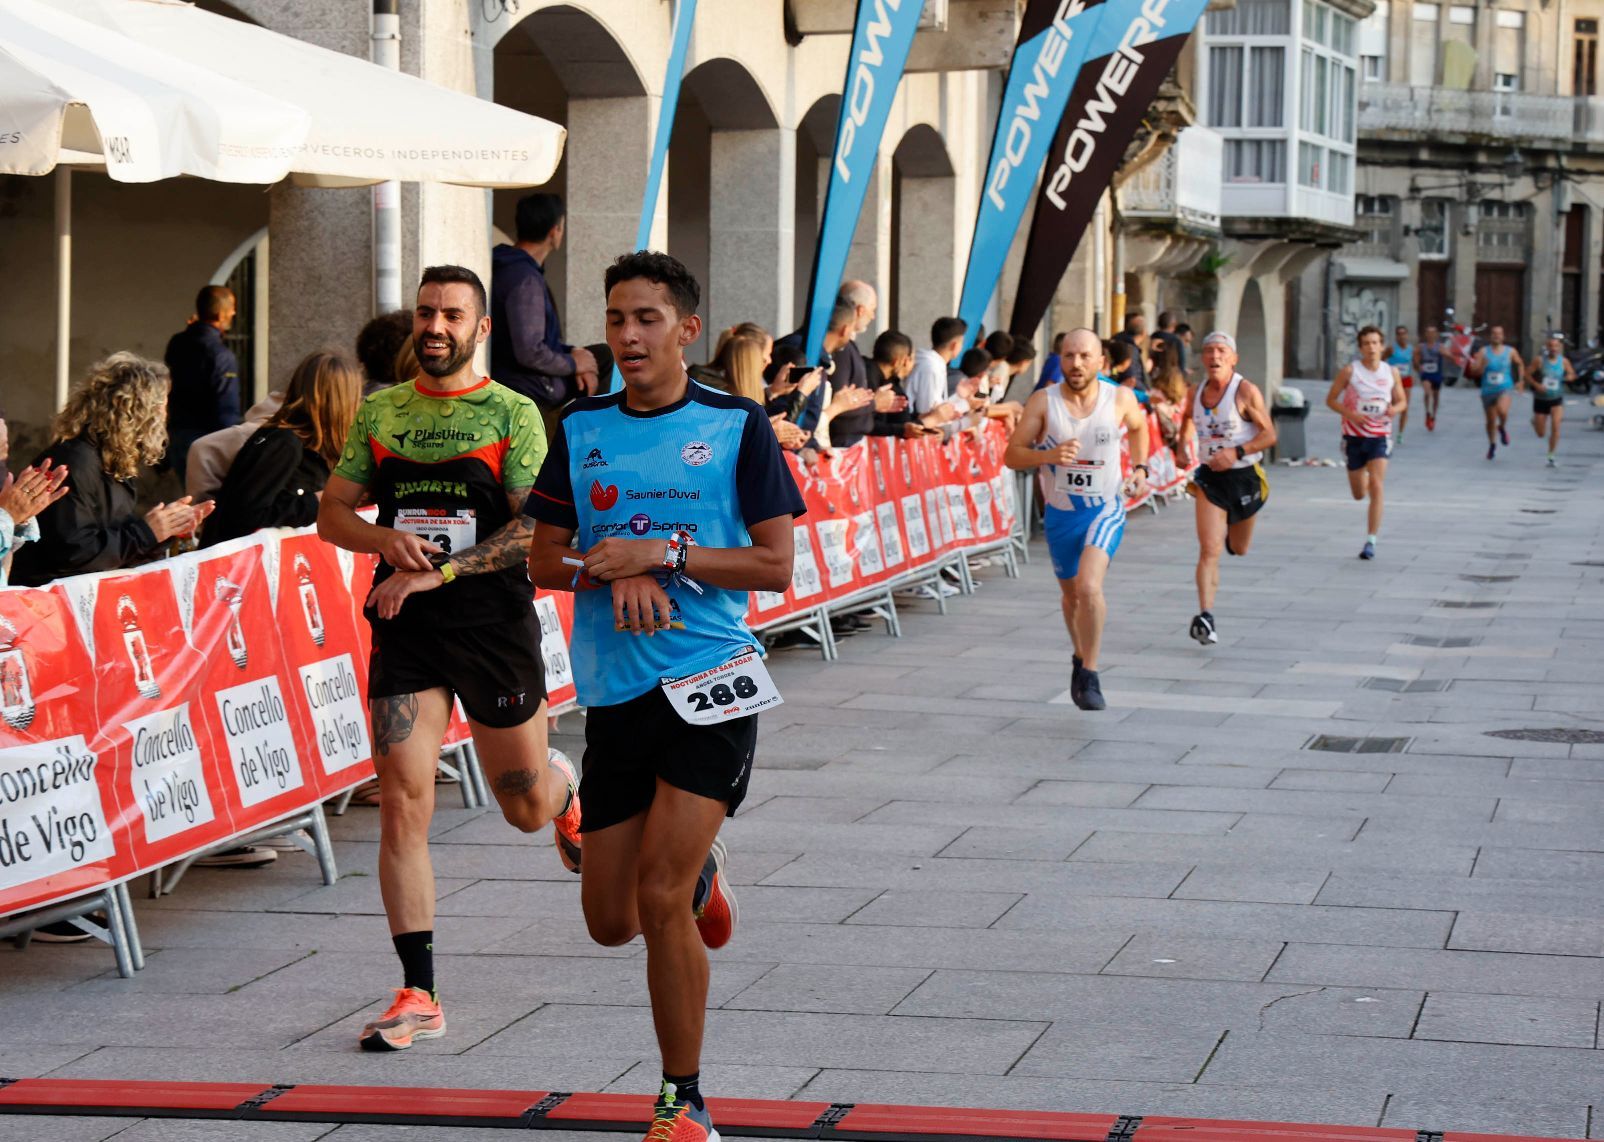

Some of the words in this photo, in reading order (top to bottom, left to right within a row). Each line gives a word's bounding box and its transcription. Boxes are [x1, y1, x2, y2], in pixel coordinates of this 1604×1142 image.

[392, 149, 529, 162] INDEPENDIENTES
[411, 441, 445, 449] Seguros
[413, 429, 476, 441] PlusUltra
[625, 489, 667, 500] Saunier
[668, 488, 701, 500] Duval
[1066, 472, 1092, 487] 161
[652, 520, 698, 533] Spring
[305, 661, 356, 709] Concello
[670, 672, 709, 691] NOCTURNA
[708, 667, 720, 677] DE
[719, 662, 734, 672] SAN
[734, 655, 753, 667] XOAN
[223, 684, 285, 737] Concello
[686, 675, 759, 713] 288
[134, 711, 193, 768] Concello
[322, 719, 339, 757] de
[333, 713, 362, 760] Vigo
[240, 746, 260, 789] de
[256, 739, 290, 790] Vigo
[144, 778, 167, 823] de
[162, 770, 200, 824] Vigo
[0, 817, 32, 868] de
[31, 805, 97, 863] Vigo
